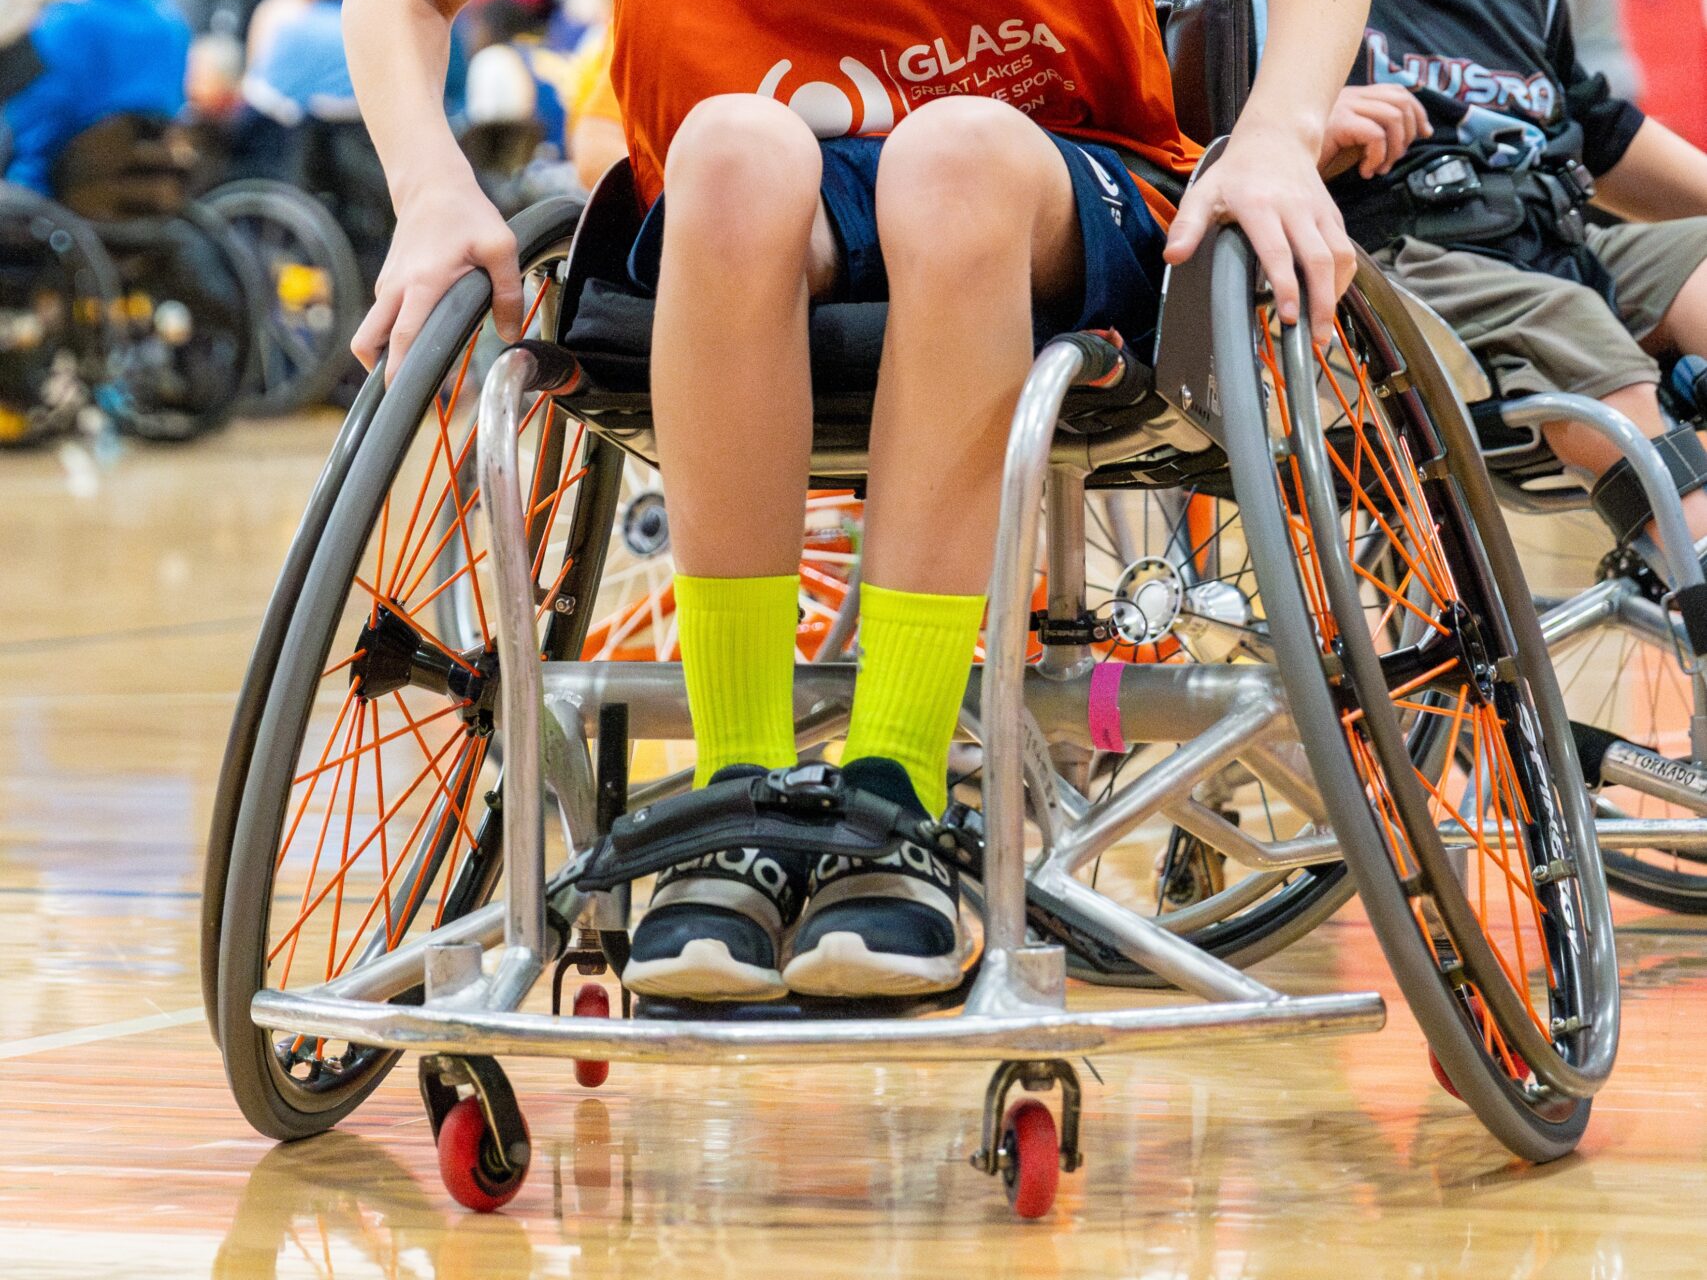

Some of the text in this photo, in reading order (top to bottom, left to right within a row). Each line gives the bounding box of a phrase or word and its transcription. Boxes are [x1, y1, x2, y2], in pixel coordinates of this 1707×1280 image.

[898, 19, 1066, 82] GLASA
[910, 77, 970, 101] GREAT
[973, 54, 1033, 88] LAKES
[1011, 68, 1076, 98] SPORS
[1634, 752, 1697, 786] TORNADO
